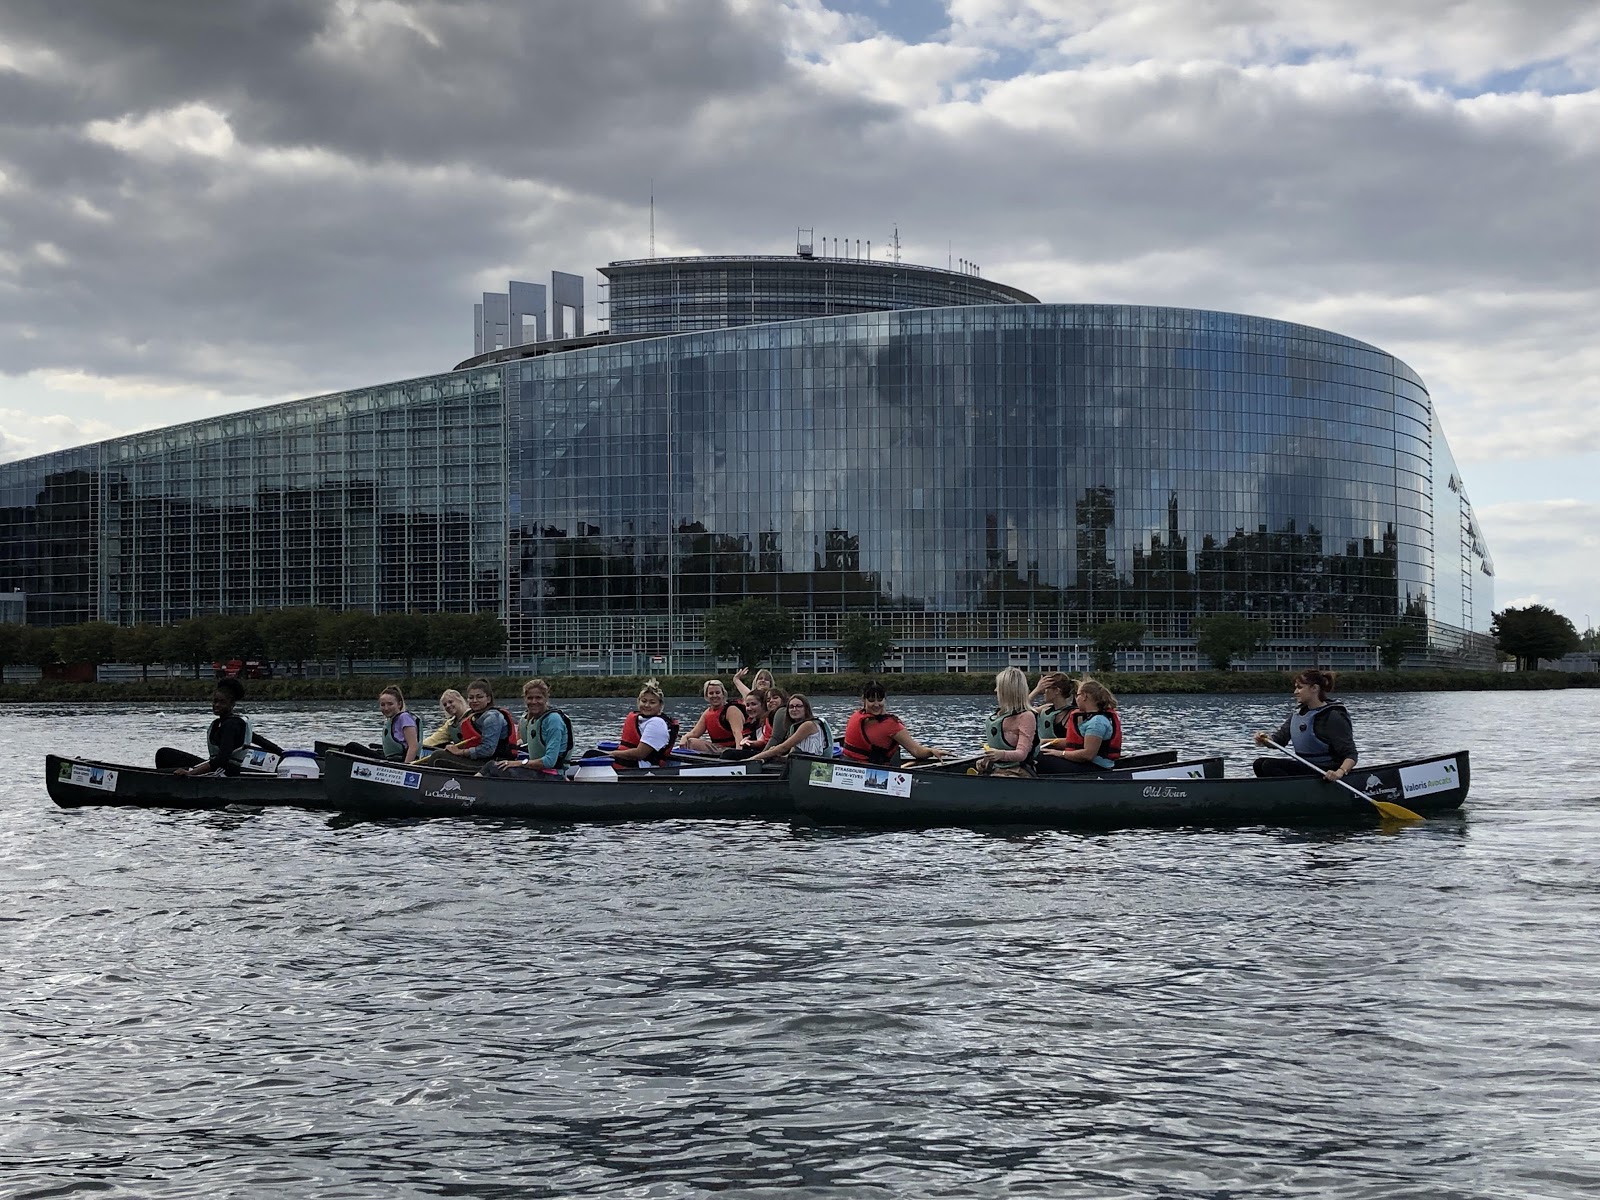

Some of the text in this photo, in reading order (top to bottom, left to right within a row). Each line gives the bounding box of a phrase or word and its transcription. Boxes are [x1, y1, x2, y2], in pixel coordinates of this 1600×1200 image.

[834, 766, 865, 775] STRASBOURG
[1404, 777, 1452, 792] Valoris Avocats
[1143, 786, 1187, 797] Old Town
[454, 794, 476, 802] Fromage
